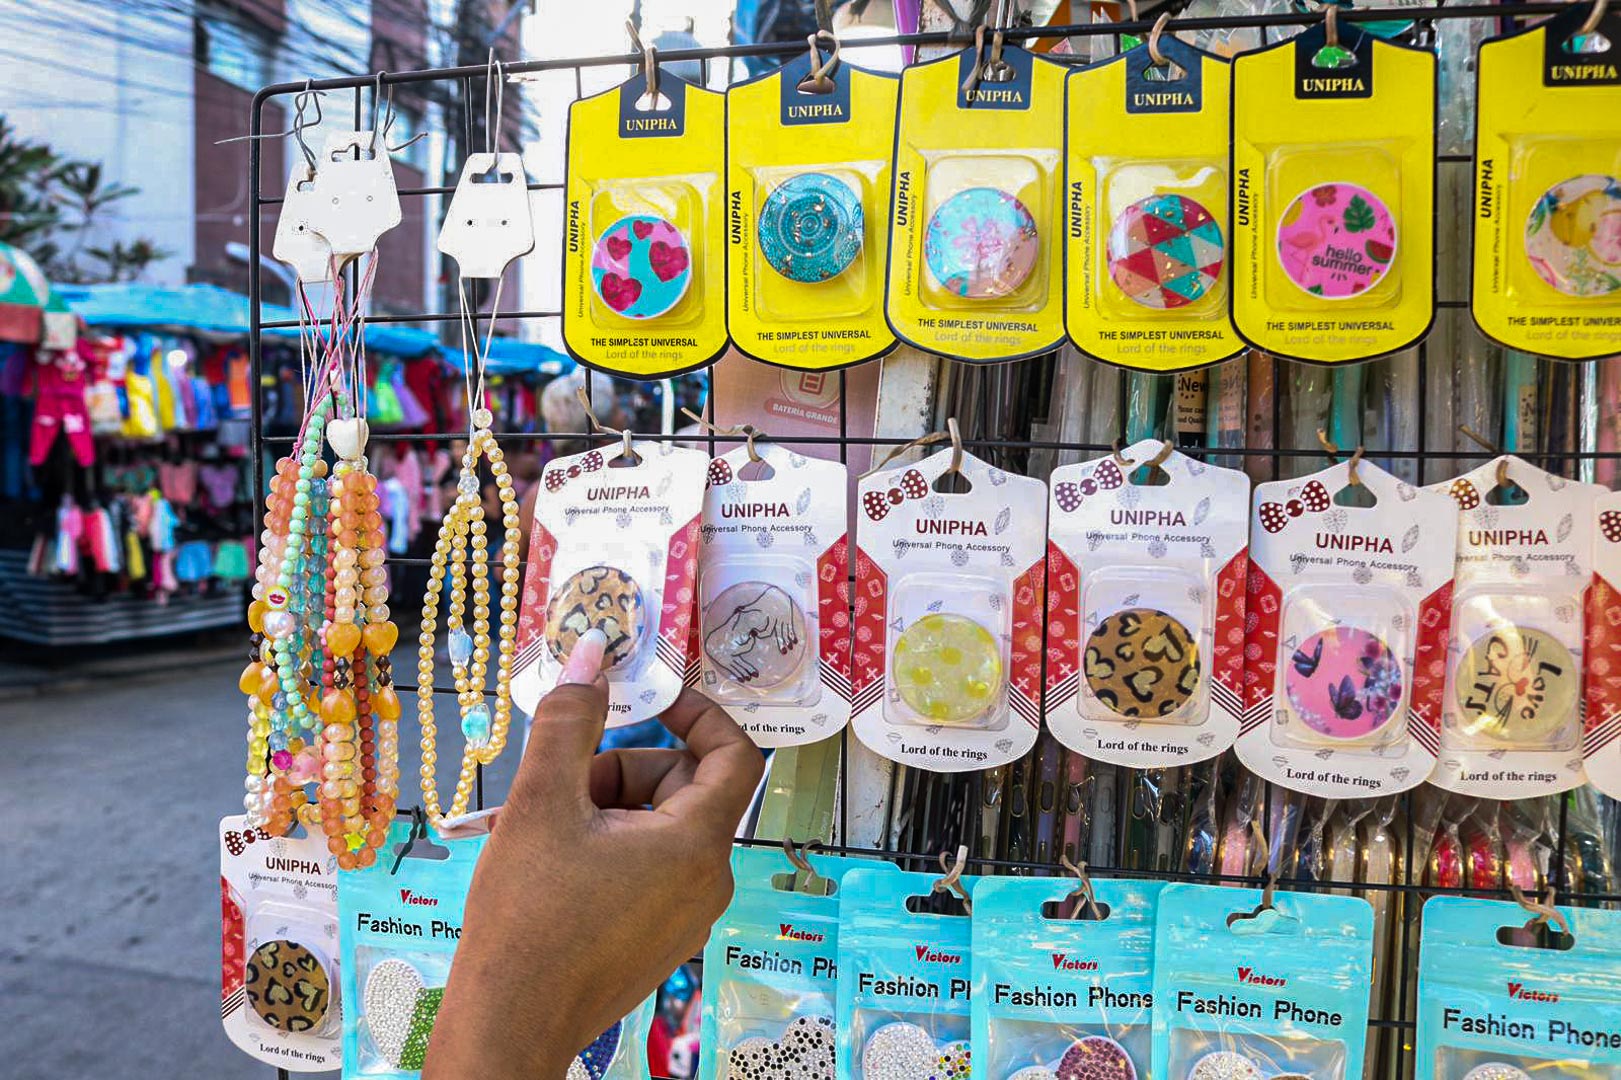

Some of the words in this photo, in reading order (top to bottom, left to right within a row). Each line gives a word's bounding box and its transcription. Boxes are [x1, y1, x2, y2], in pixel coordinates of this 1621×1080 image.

[1551, 64, 1618, 80] UNIPHA
[1302, 77, 1365, 92] UNIPHA
[966, 90, 1023, 102] UNIPHA
[1134, 93, 1194, 106] UNIPHA
[788, 105, 843, 119] UNIPHA
[626, 118, 677, 131] UNIPHA
[1480, 159, 1493, 218] UNIPHA
[897, 171, 911, 226] UNIPHA
[1238, 168, 1250, 226] UNIPHA
[731, 191, 741, 244] UNIPHA
[1071, 181, 1082, 238] UNIPHA
[569, 200, 579, 252] UNIPHA
[1325, 244, 1362, 263] hello
[1312, 255, 1373, 276] summer
[918, 318, 935, 328] THE
[938, 319, 983, 329] SIMPLEST
[986, 321, 1038, 332] UNIVERSAL
[1266, 322, 1285, 331] THE
[1287, 322, 1336, 331] SIMPLEST
[1338, 321, 1394, 331] UNIVERSAL
[1508, 316, 1527, 326] THE
[1530, 316, 1580, 326] SIMPLEST
[591, 338, 606, 347] THE
[608, 338, 649, 347] SIMPLEST
[651, 338, 698, 347] UNIVERSAL
[757, 332, 774, 341] THE
[776, 331, 819, 340] SIMPLEST
[821, 330, 871, 339] UNIVERSAL
[1098, 331, 1117, 340] THE
[1120, 331, 1167, 340] SIMPLEST
[1169, 330, 1224, 340] UNIVERSAL
[606, 350, 626, 359] Lord
[629, 349, 639, 359] of
[642, 349, 656, 359] the
[660, 350, 682, 361] rings
[1117, 343, 1140, 353] Lord
[1144, 343, 1155, 353] of
[1159, 343, 1176, 353] the
[1180, 344, 1206, 355] rings
[587, 486, 650, 501] UNIPHA
[630, 505, 669, 513] Accessory
[721, 502, 790, 518] UNIPHA
[1110, 510, 1186, 526] UNIPHA
[741, 525, 767, 533] Phone
[770, 524, 812, 533] Accessory
[916, 519, 988, 536] UNIPHA
[1132, 533, 1160, 542] Phone
[1164, 534, 1211, 544] Accessory
[1315, 533, 1394, 554] UNIPHA
[1469, 529, 1549, 546] UNIPHA
[935, 541, 963, 550] Phone
[966, 542, 1011, 553] Accessory
[1336, 557, 1366, 568] Phone
[1370, 560, 1419, 573] Accessory
[1492, 553, 1522, 561] Phone
[1526, 553, 1575, 562] Accessory
[608, 703, 632, 713] rings
[750, 723, 761, 732] of
[762, 723, 778, 733] the
[780, 724, 806, 734] rings
[901, 744, 927, 755] Lord
[929, 745, 942, 756] of
[942, 747, 959, 758] the
[961, 749, 988, 761] rings
[1097, 740, 1125, 750] Lord
[1127, 741, 1141, 751] of
[1141, 742, 1160, 752] the
[1161, 743, 1188, 755] rings
[1286, 768, 1314, 781] Lord
[1317, 772, 1332, 782] of
[1332, 773, 1350, 785] the
[1351, 776, 1382, 789] rings
[1460, 771, 1489, 782] Lord
[1492, 771, 1503, 781] of
[1507, 771, 1524, 781] the
[1528, 772, 1556, 783] rings
[266, 856, 321, 875] UNIPHA
[358, 913, 423, 936] Fashion
[725, 946, 802, 975] Fashion
[813, 957, 838, 979] Ph
[859, 973, 939, 998] Fashion
[995, 984, 1077, 1008] Fashion
[1089, 985, 1153, 1009] Phone
[1177, 991, 1262, 1018] Fashion
[1274, 1001, 1343, 1027] Phone
[1443, 1008, 1535, 1040] Fashion
[1548, 1019, 1621, 1048] Phone
[260, 1043, 279, 1055] Lord
[281, 1048, 289, 1057] of
[291, 1049, 304, 1059] the
[305, 1052, 326, 1064] rings
